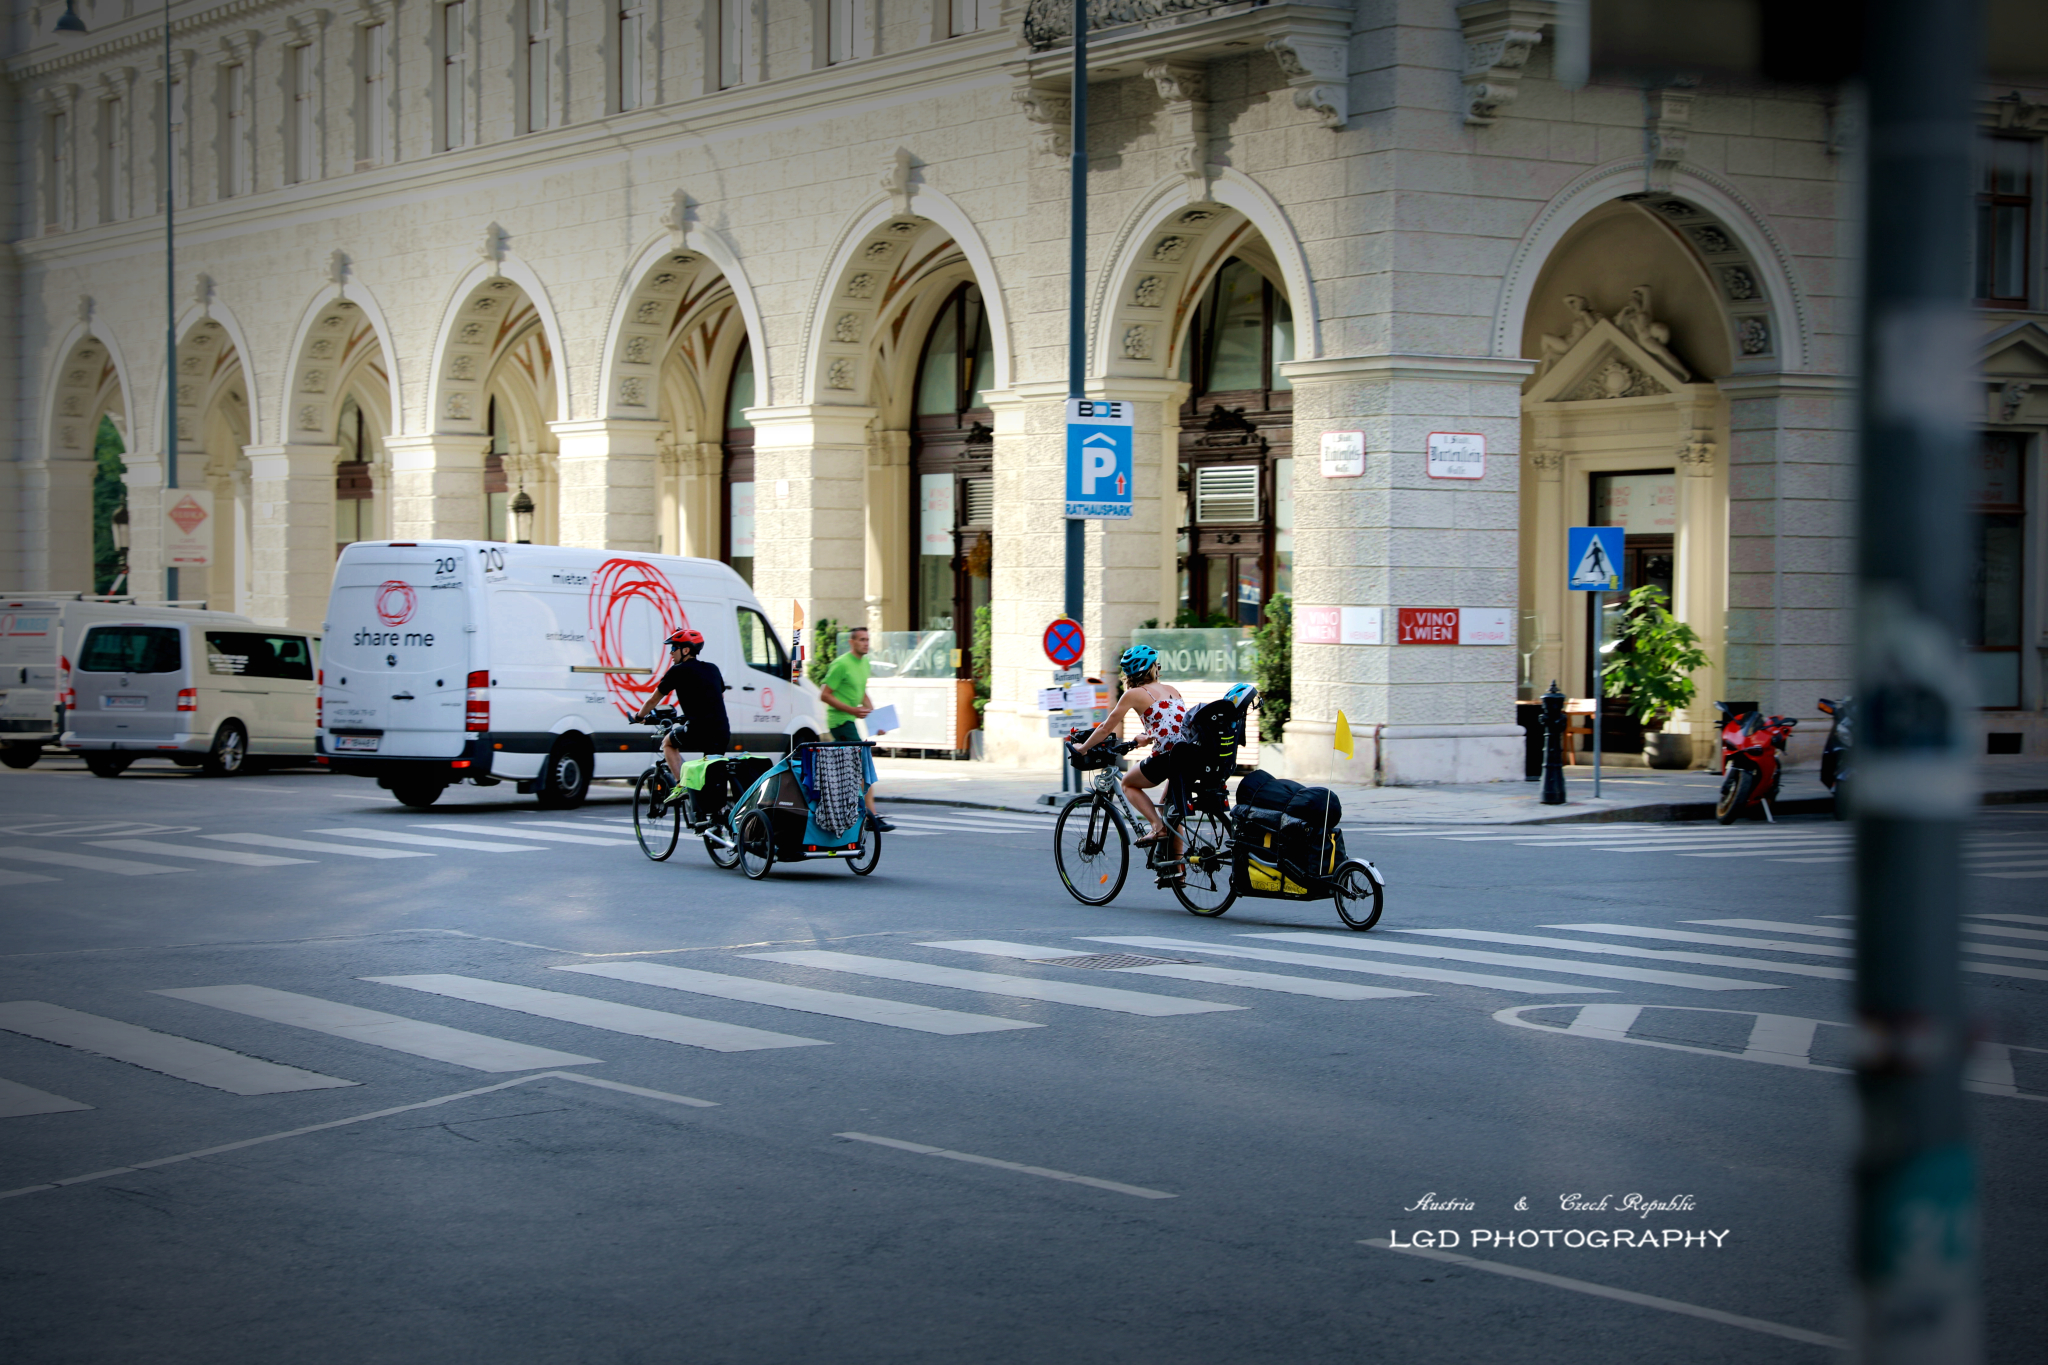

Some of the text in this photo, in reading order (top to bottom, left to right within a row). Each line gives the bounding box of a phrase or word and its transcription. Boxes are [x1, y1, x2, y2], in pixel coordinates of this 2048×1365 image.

[1065, 503, 1133, 517] RATHAUSPARK
[435, 557, 456, 574] 20
[479, 547, 504, 573] 20
[552, 569, 590, 586] mieten
[1309, 611, 1339, 627] VINO
[1416, 612, 1457, 627] VINO
[353, 626, 435, 648] share me
[1307, 626, 1337, 640] WIEN
[1413, 626, 1453, 641] WIEN
[1194, 649, 1237, 673] WIEN
